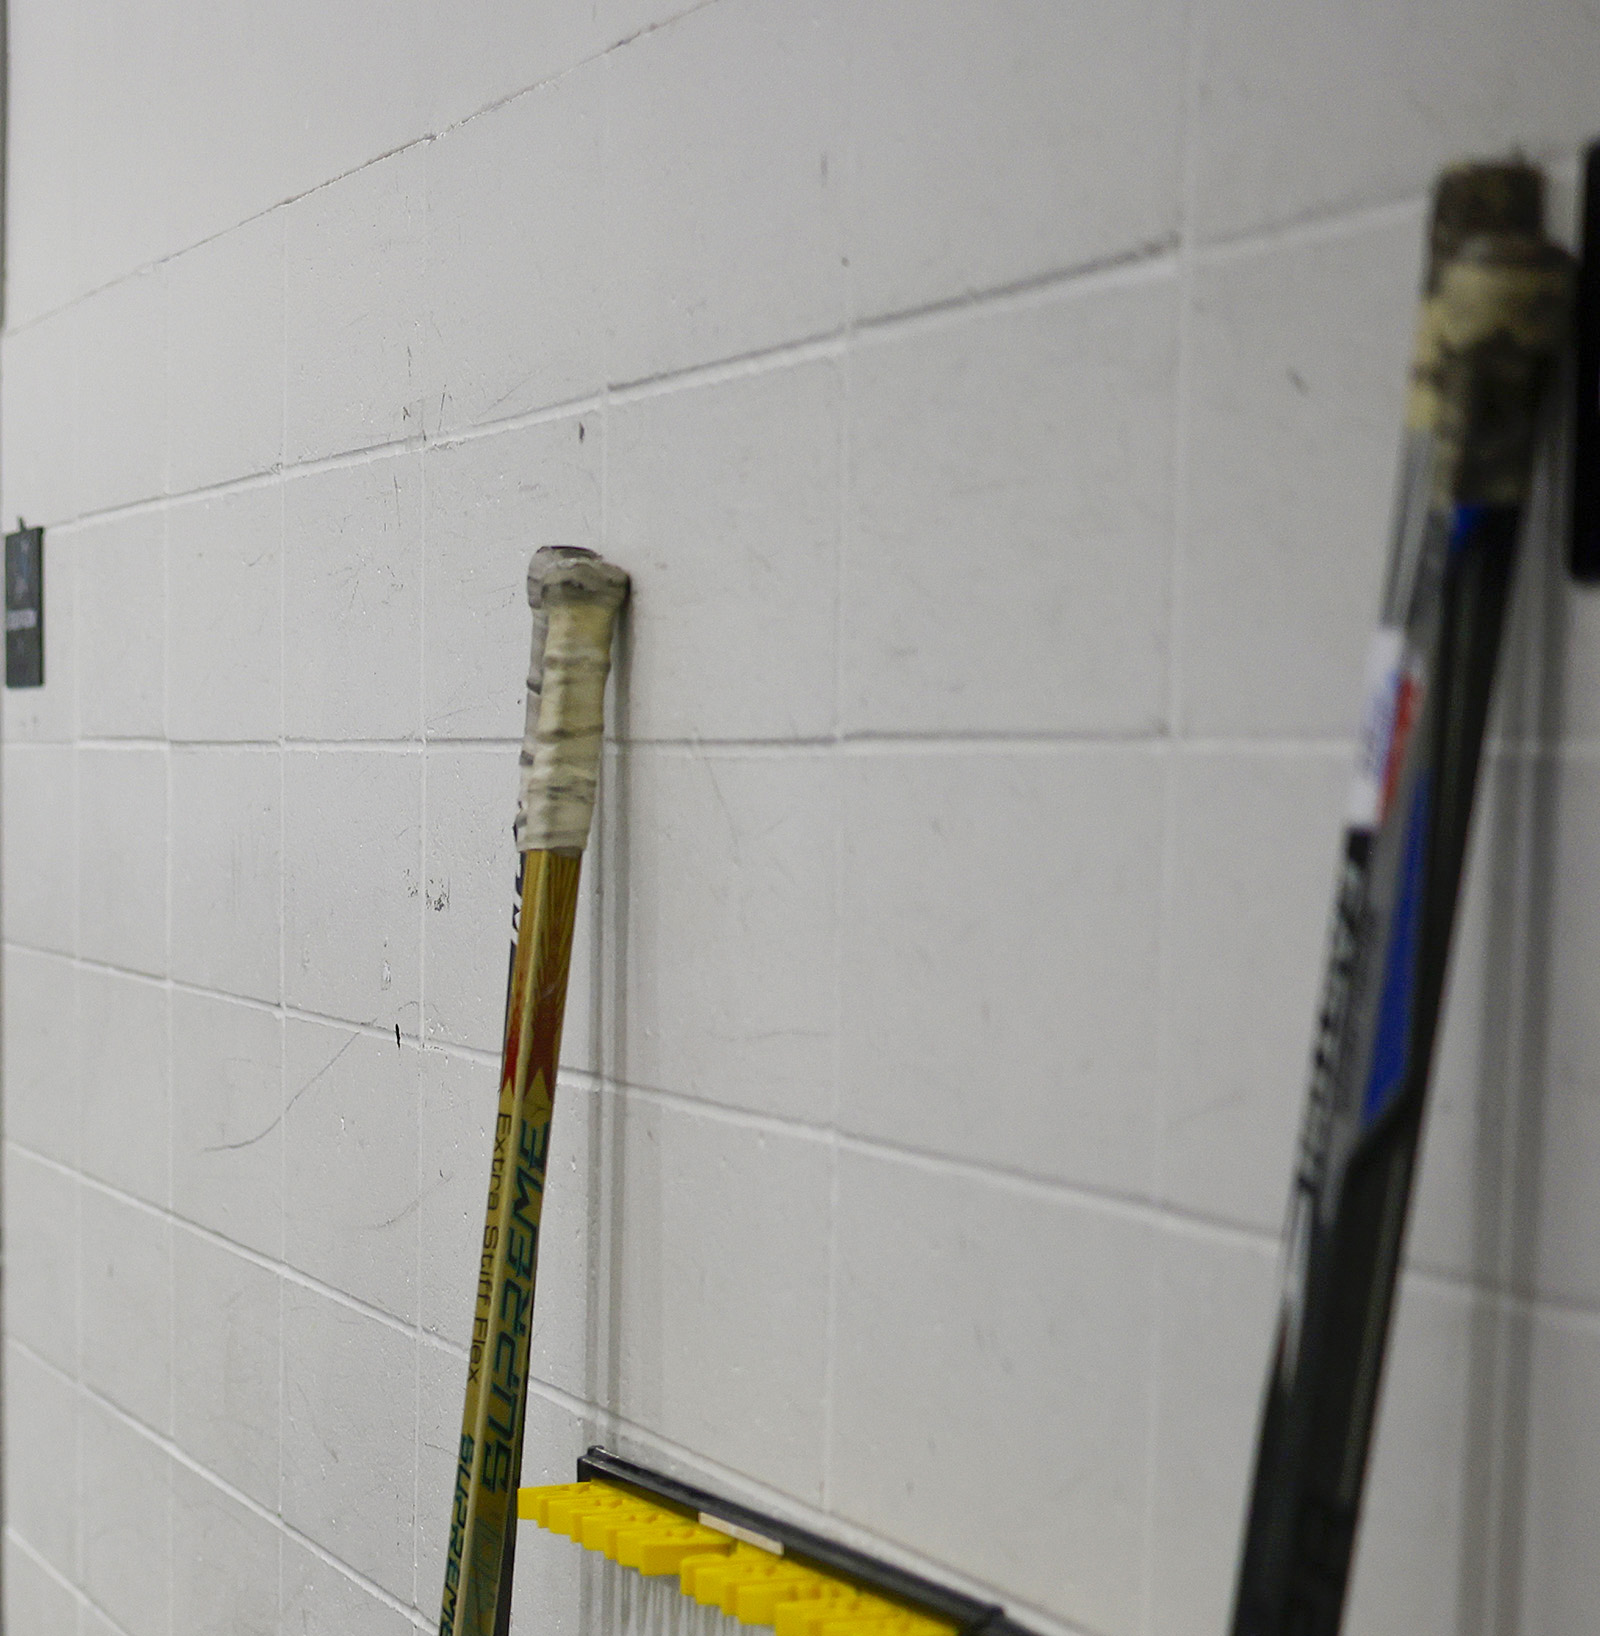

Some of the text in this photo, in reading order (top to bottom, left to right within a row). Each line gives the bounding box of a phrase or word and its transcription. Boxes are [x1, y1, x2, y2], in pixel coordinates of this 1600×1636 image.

[467, 1112, 512, 1383] Extra Stiff Flex
[481, 1118, 550, 1495] SUPREME
